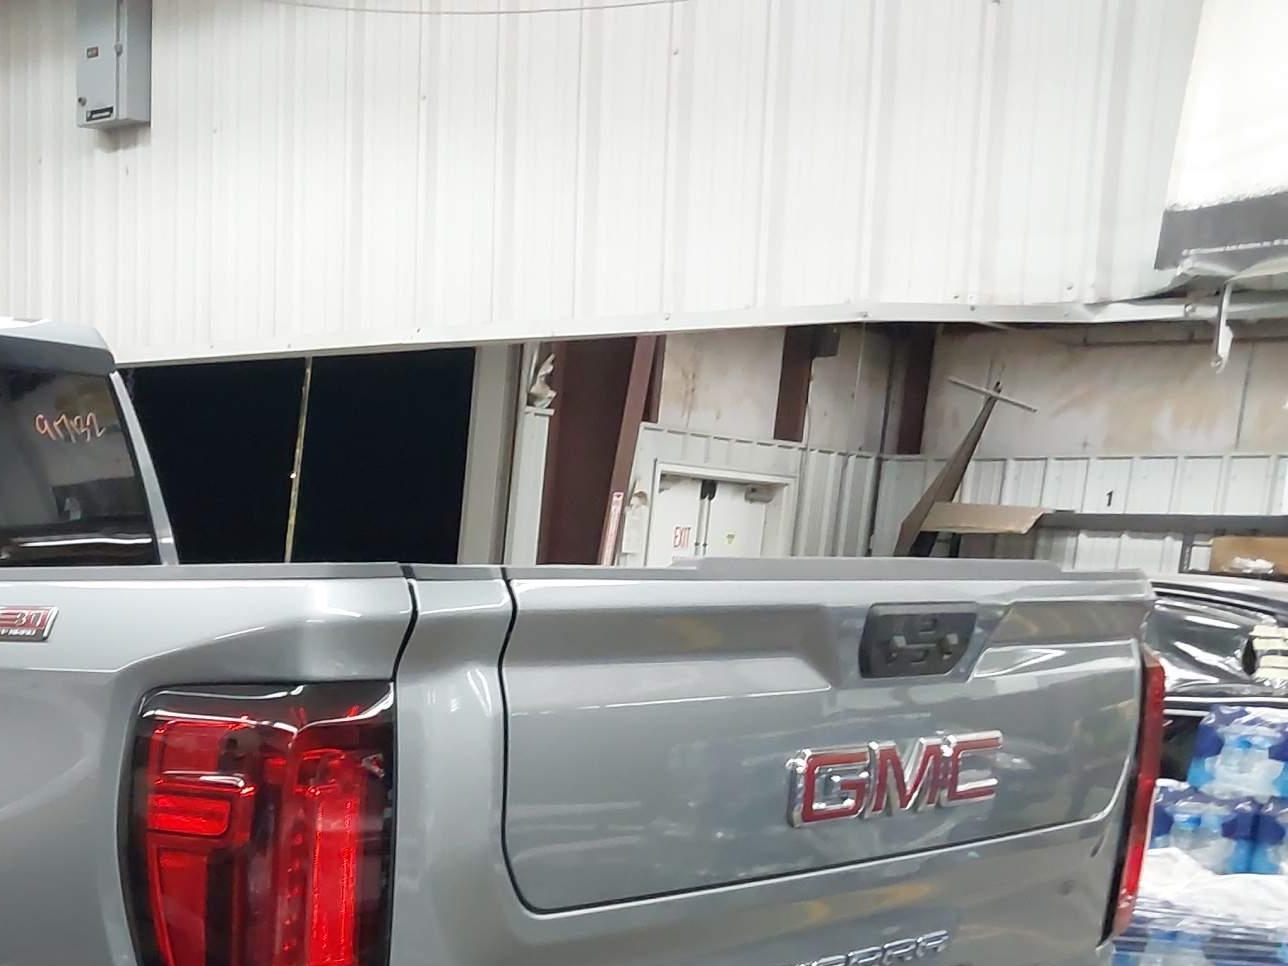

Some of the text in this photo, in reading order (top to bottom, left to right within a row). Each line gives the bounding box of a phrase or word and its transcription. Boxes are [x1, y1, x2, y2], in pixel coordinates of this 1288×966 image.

[1106, 490, 1114, 507] 1
[673, 526, 692, 549] EXIT
[786, 730, 1003, 827] GMC
